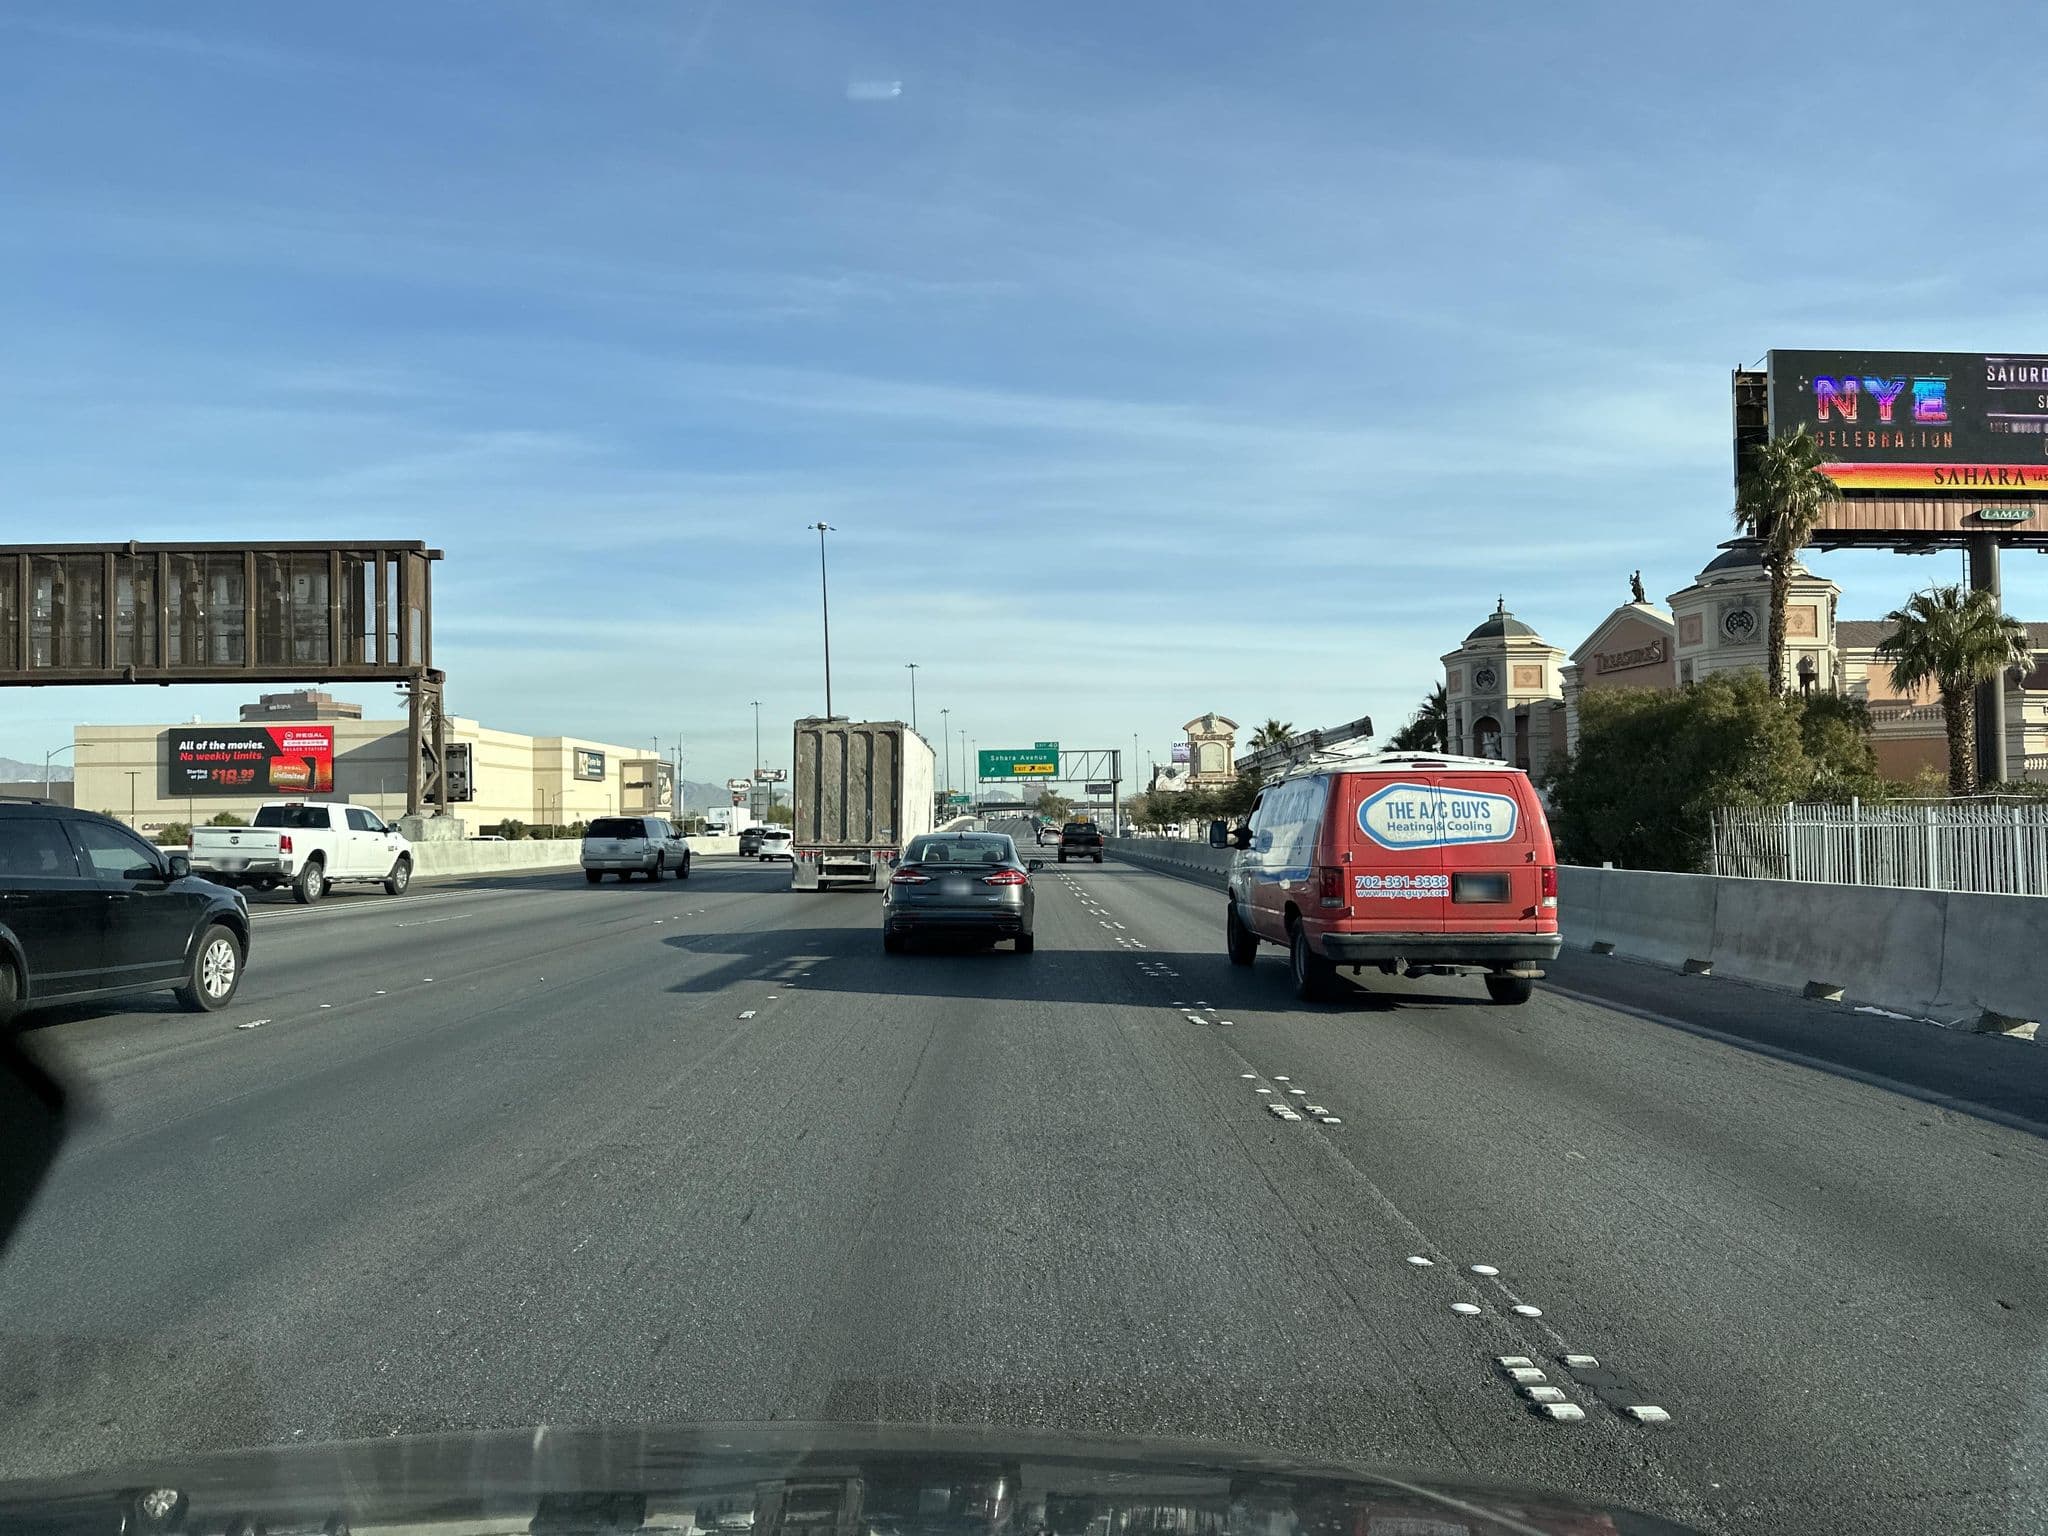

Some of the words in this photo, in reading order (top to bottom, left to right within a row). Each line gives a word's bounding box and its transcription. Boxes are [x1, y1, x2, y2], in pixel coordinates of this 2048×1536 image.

[1814, 376, 1953, 422] NYE
[1815, 431, 1953, 448] CELEBRATION
[1934, 467, 2026, 486] SAHARA
[1985, 510, 2029, 519] LAMAR
[179, 741, 194, 750] All
[196, 741, 208, 750] of
[209, 741, 226, 750] the
[227, 740, 266, 750] movies.
[180, 752, 193, 760] No
[196, 751, 231, 762] weekly
[211, 769, 255, 784] $18.99
[1386, 801, 1415, 819] THE
[1419, 801, 1448, 819] A/C
[1451, 801, 1491, 819] GUYS
[1387, 821, 1434, 833] Heating
[1436, 822, 1445, 832] &
[1447, 821, 1492, 833] Cooling
[1356, 889, 1449, 899] www.myacguys.com
